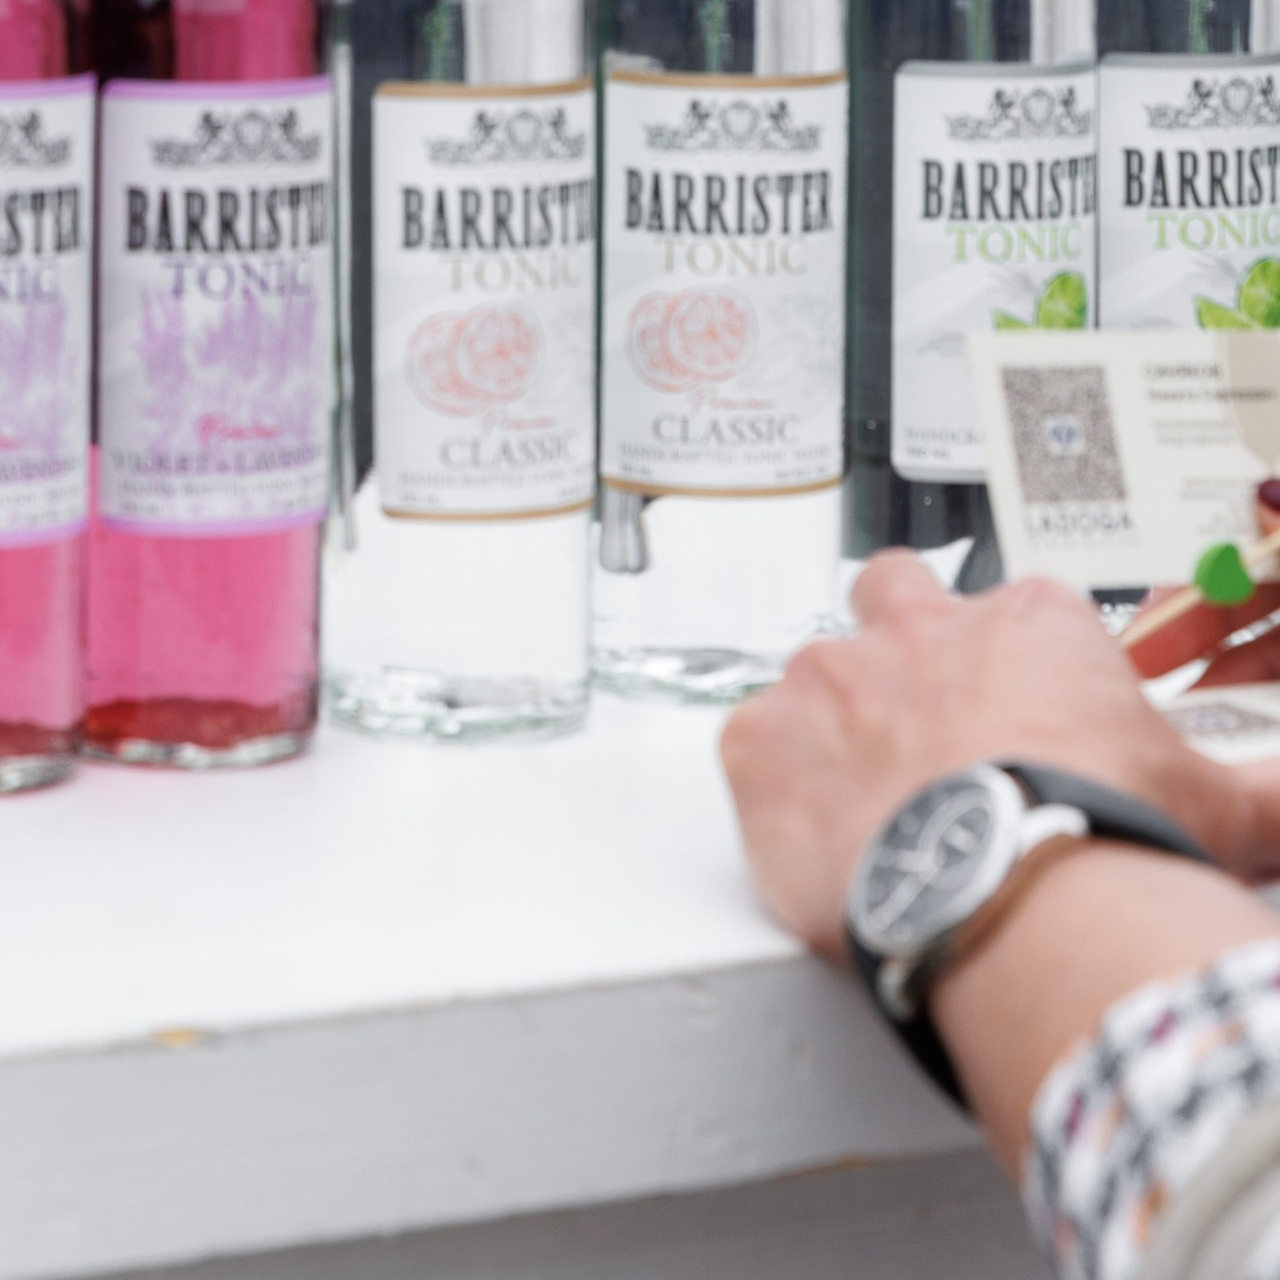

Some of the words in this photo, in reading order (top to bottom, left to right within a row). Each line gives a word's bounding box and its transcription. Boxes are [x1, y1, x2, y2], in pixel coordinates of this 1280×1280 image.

[624, 167, 832, 235] BARRISTER
[655, 237, 808, 277] TONIC
[945, 220, 1083, 264] TONIC
[651, 411, 801, 446] CLASSIC
